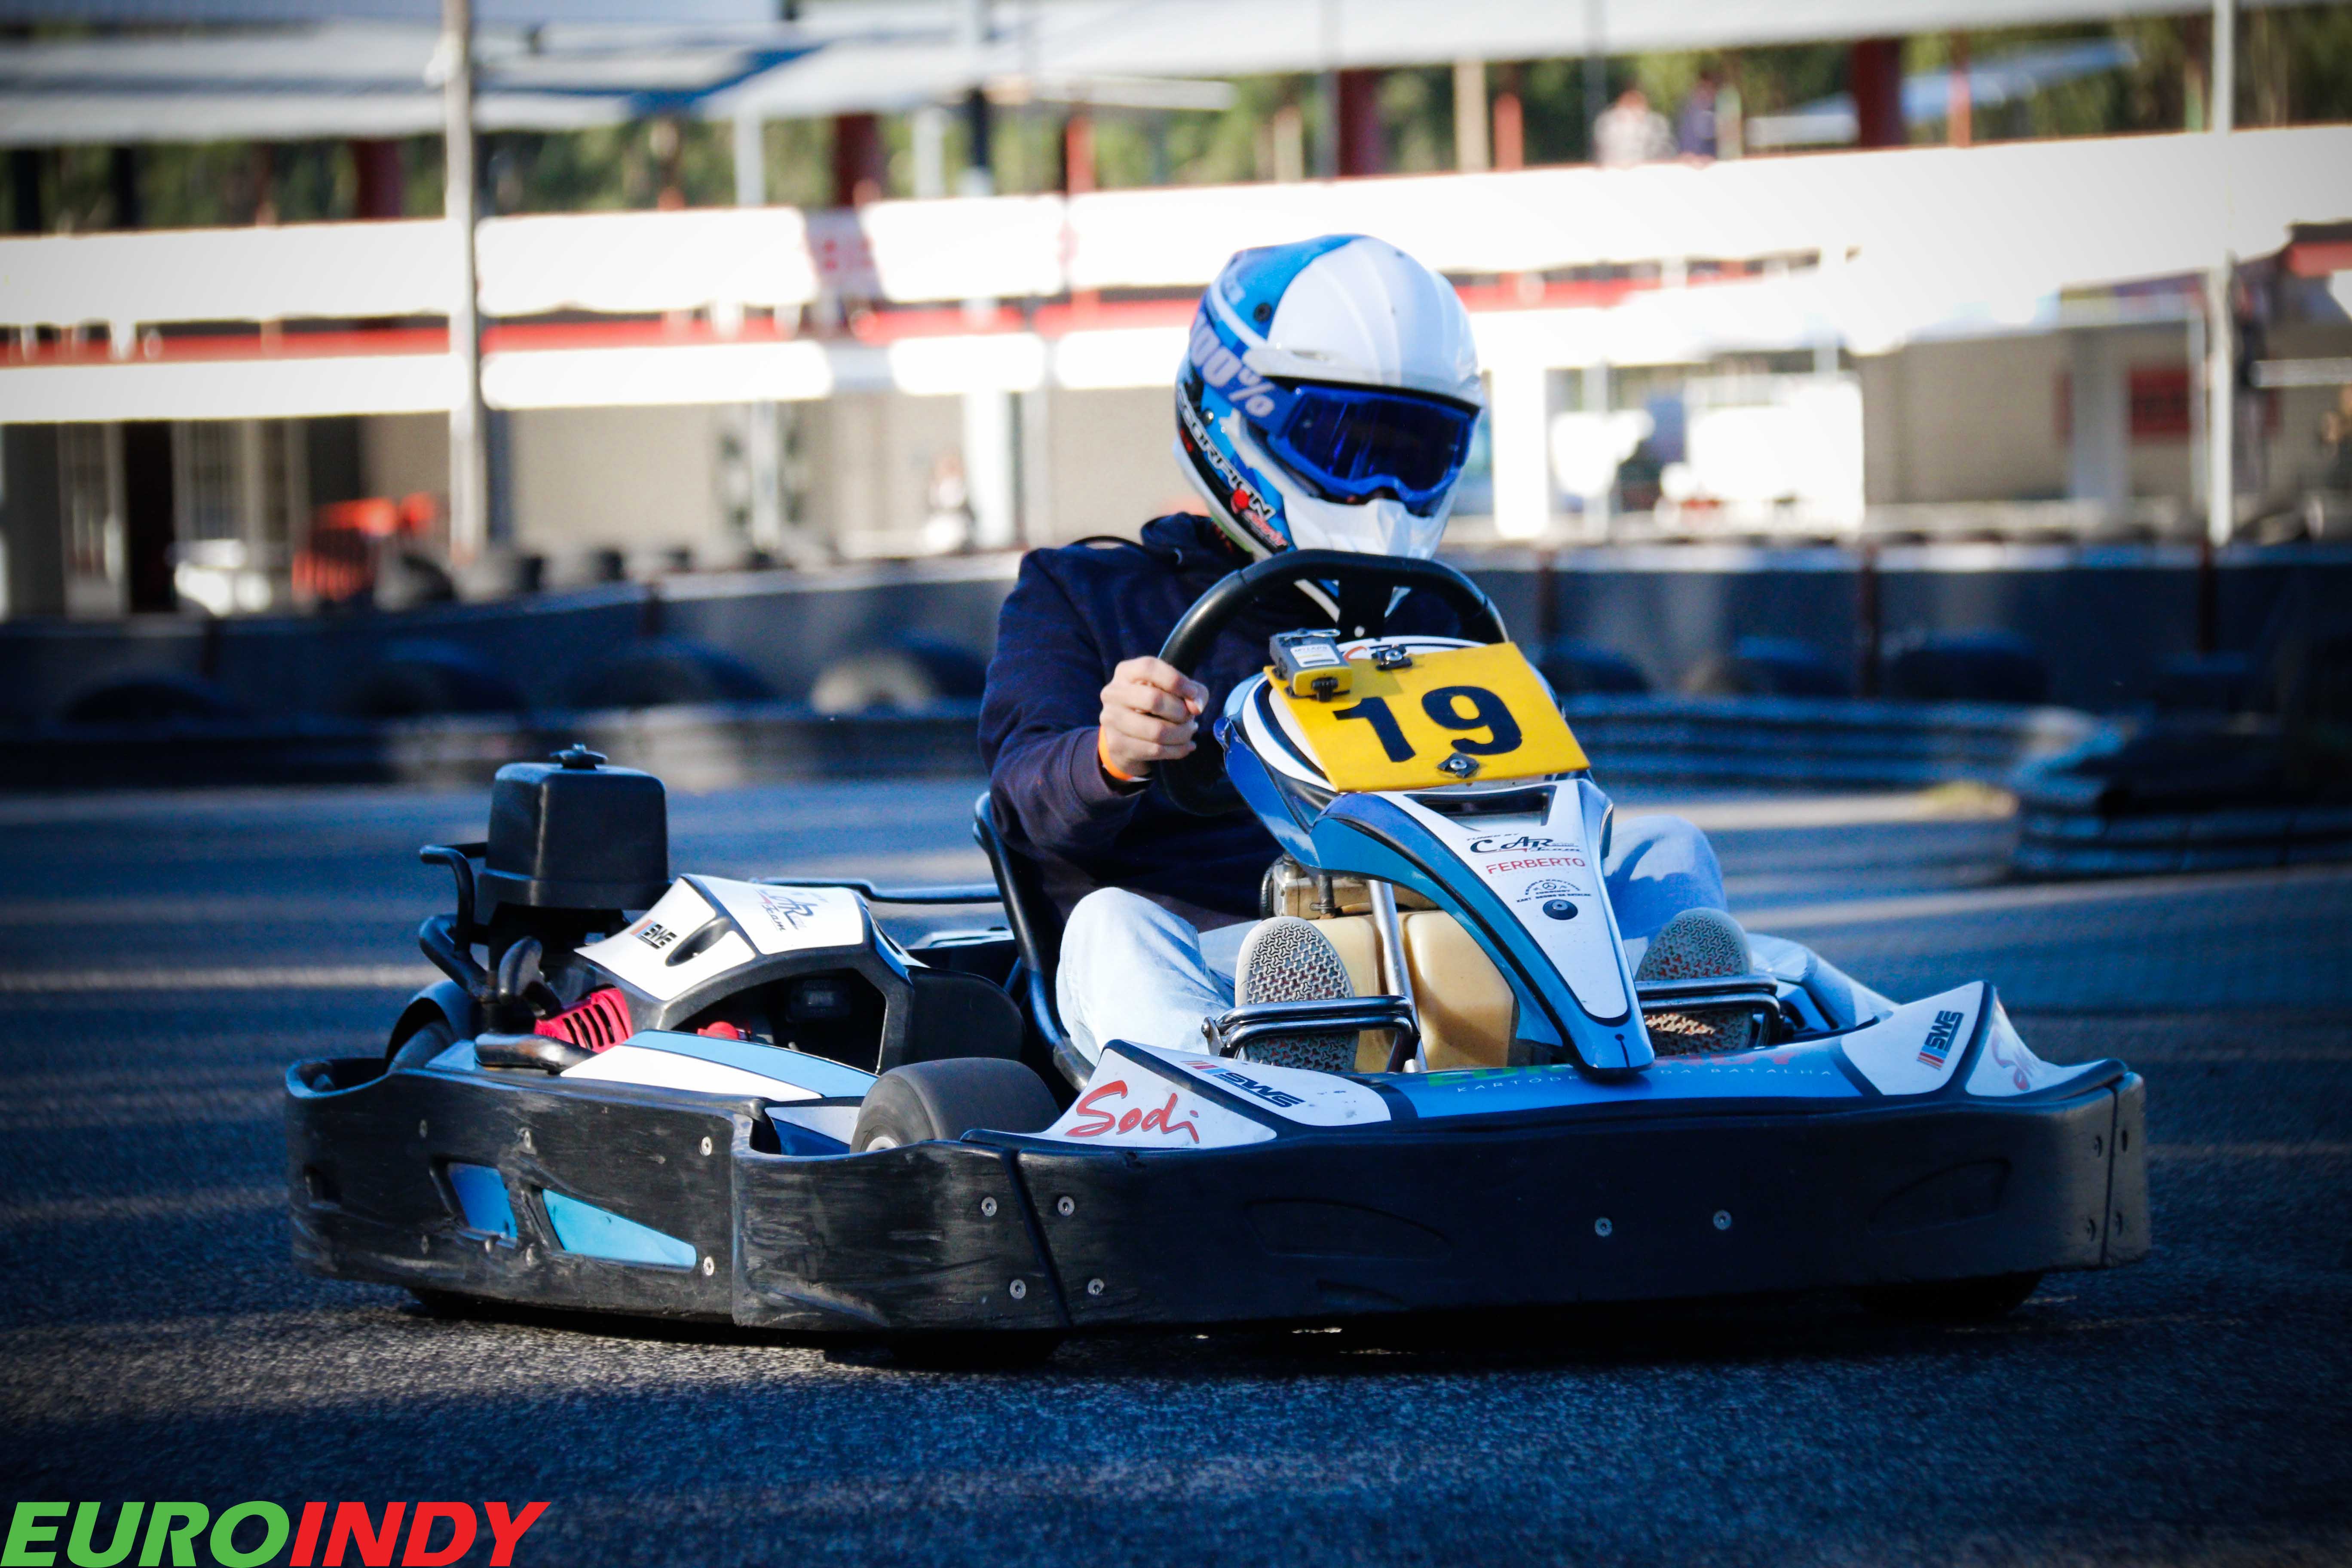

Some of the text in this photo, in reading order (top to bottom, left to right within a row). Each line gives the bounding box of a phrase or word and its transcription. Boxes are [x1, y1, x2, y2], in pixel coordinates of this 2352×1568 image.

[1333, 686, 1522, 763] 19
[1486, 858, 1586, 874] FERBERTO
[1065, 1080, 1200, 1144] Sodi
